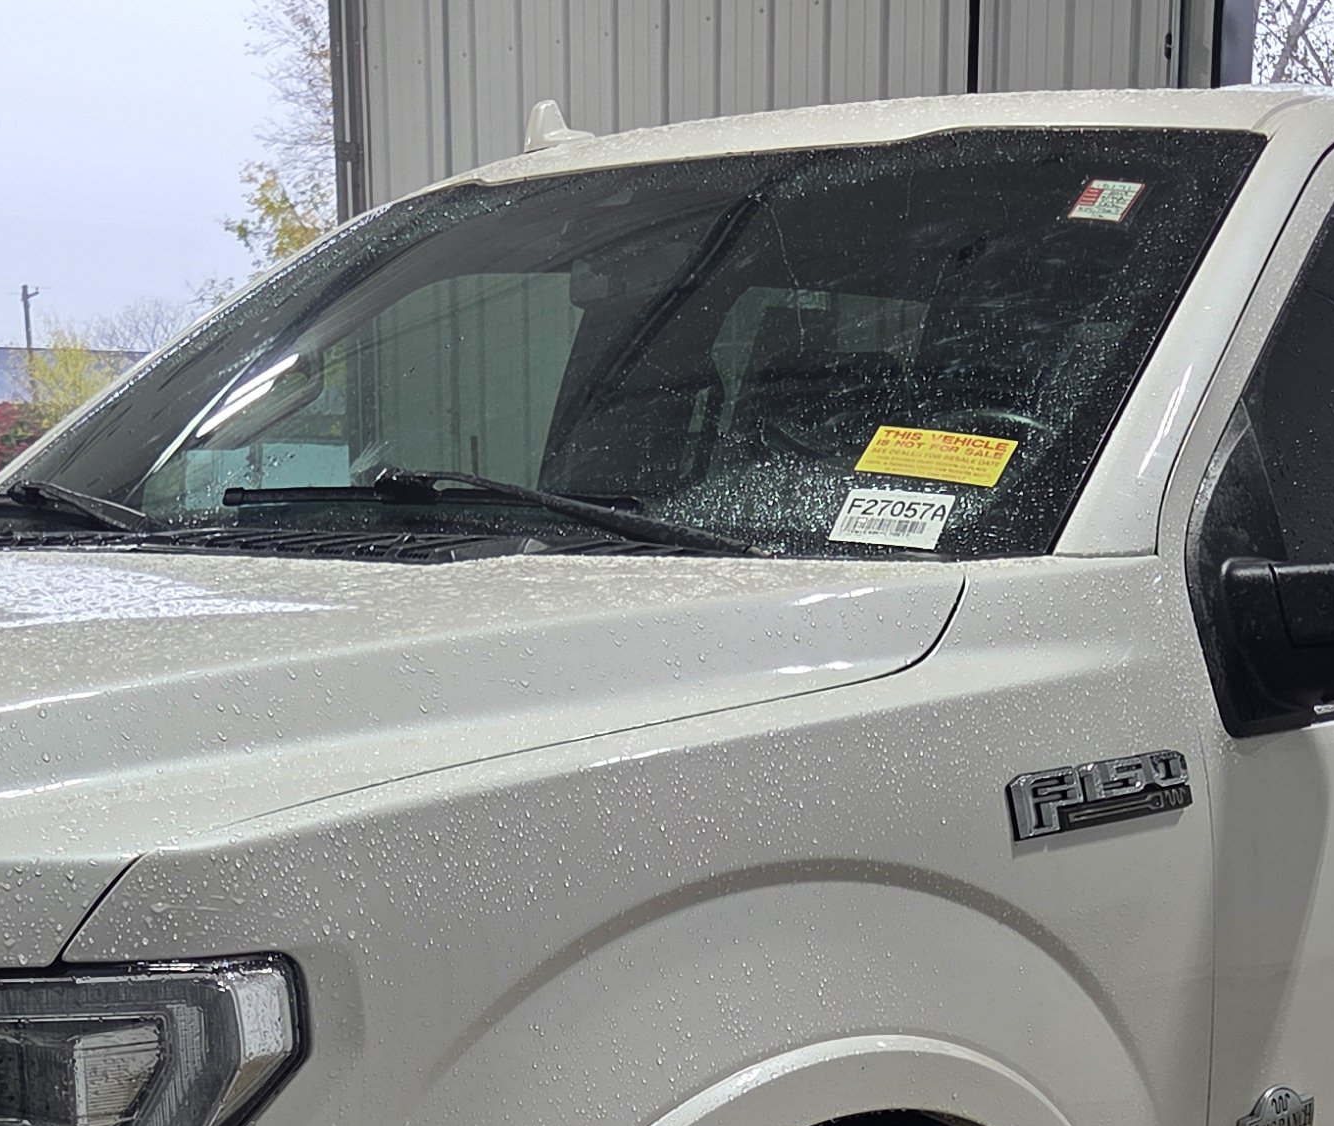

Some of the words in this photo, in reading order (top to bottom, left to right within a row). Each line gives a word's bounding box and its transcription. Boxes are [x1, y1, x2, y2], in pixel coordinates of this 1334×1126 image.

[875, 438, 890, 447] IS
[894, 440, 926, 450] NOT
[929, 443, 961, 454] FOR
[965, 447, 1005, 460] SALE
[883, 429, 923, 441] THIS
[931, 432, 1010, 452] VEHICLE
[847, 498, 947, 521] F27057A
